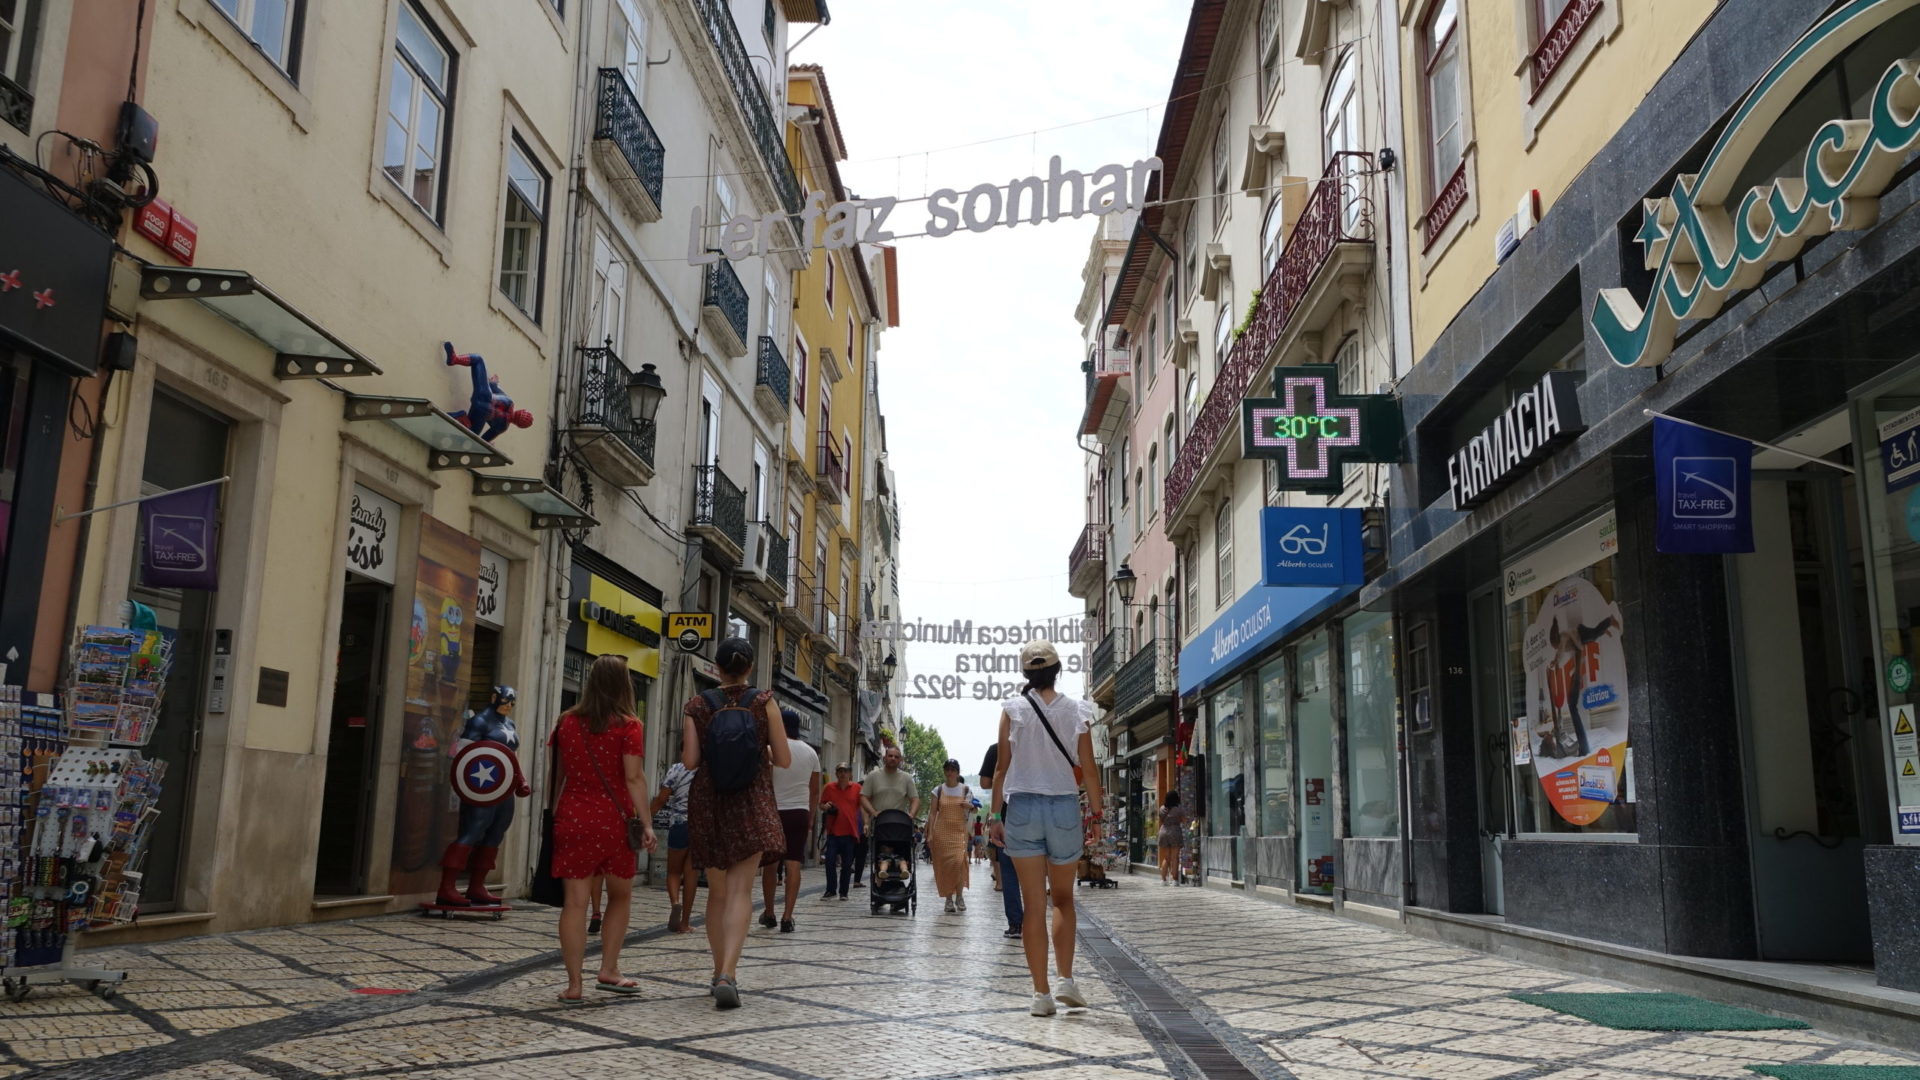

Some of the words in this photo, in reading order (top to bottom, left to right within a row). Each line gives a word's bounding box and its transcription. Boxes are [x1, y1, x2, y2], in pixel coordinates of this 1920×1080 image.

[687, 204, 785, 267] Ler
[801, 189, 897, 254] faz
[925, 154, 1163, 238] sonhar
[1274, 416, 1339, 440] 30°C
[1448, 371, 1561, 511] FARMÁCIA
[1678, 499, 1726, 510] TAX-FREE
[1697, 523, 1736, 531] SHOPPING
[154, 550, 198, 562] TAX-FREE
[1276, 560, 1307, 568] Alberto
[675, 616, 707, 626] ATM
[1210, 618, 1240, 665] Alberto
[1447, 666, 1464, 675] 136
